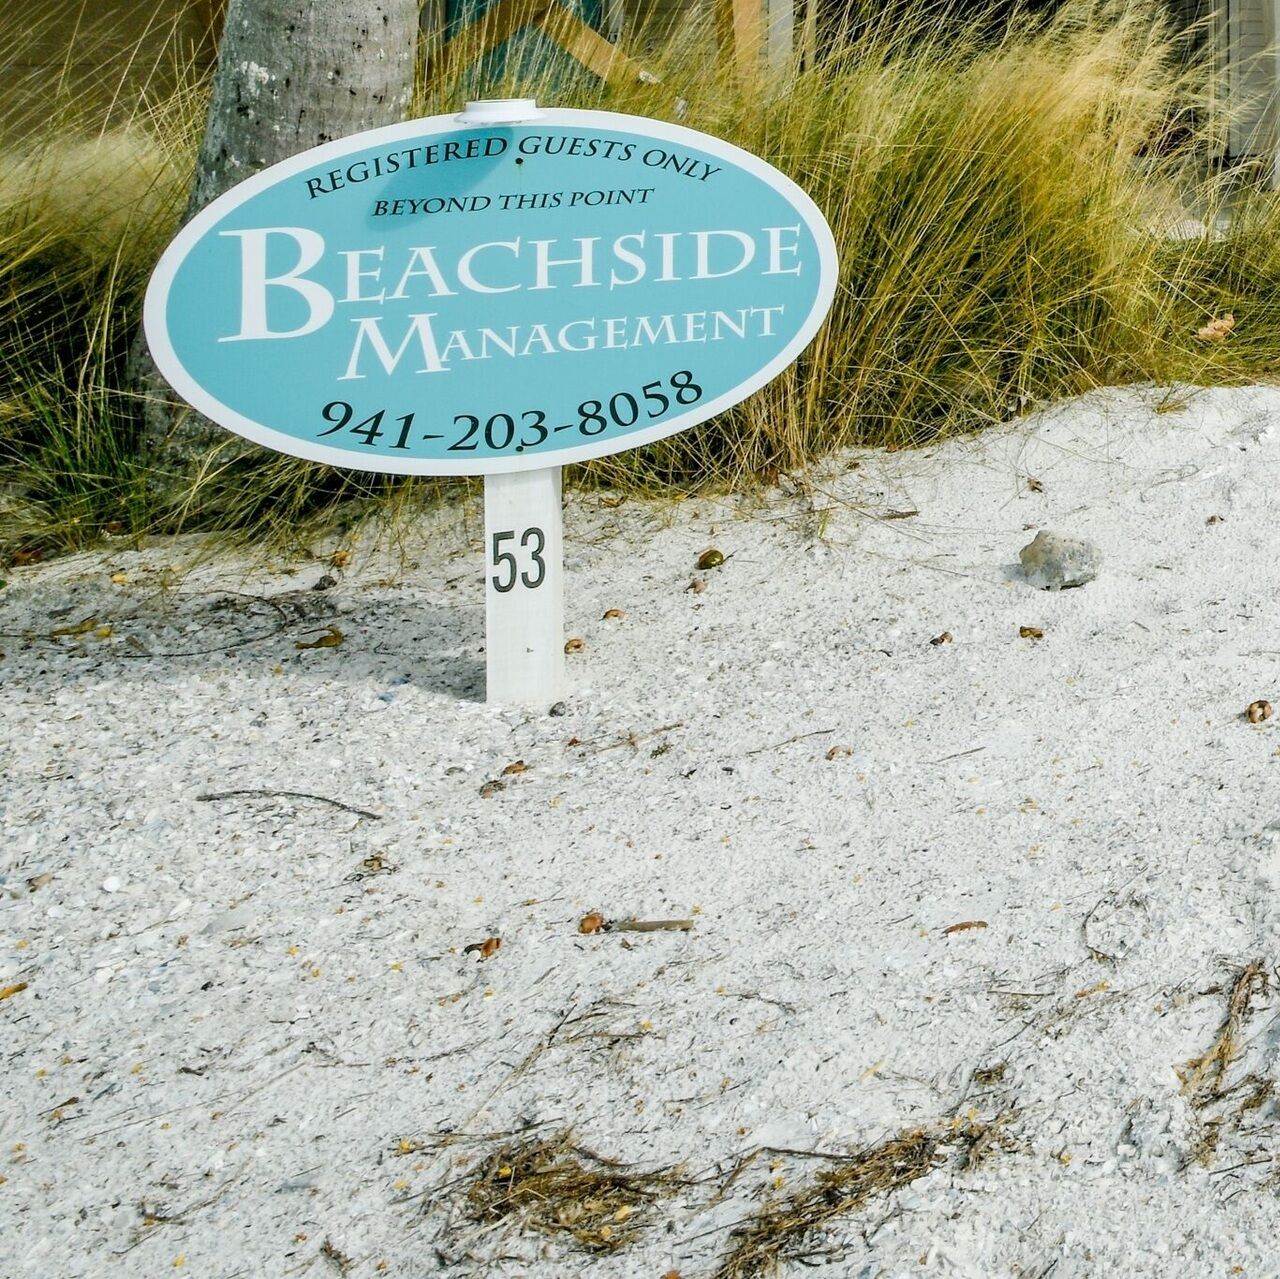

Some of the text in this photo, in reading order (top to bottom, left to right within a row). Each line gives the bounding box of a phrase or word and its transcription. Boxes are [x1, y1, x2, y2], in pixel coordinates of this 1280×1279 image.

[305, 135, 722, 200] REGISTERED GUESTS ONLY
[372, 188, 655, 217] BEYOND THIS POINT
[217, 224, 802, 344] BEACHSIDE
[337, 305, 785, 382] MANAGEMENT
[316, 369, 704, 451] 941-203-8058
[491, 527, 546, 593] 53
